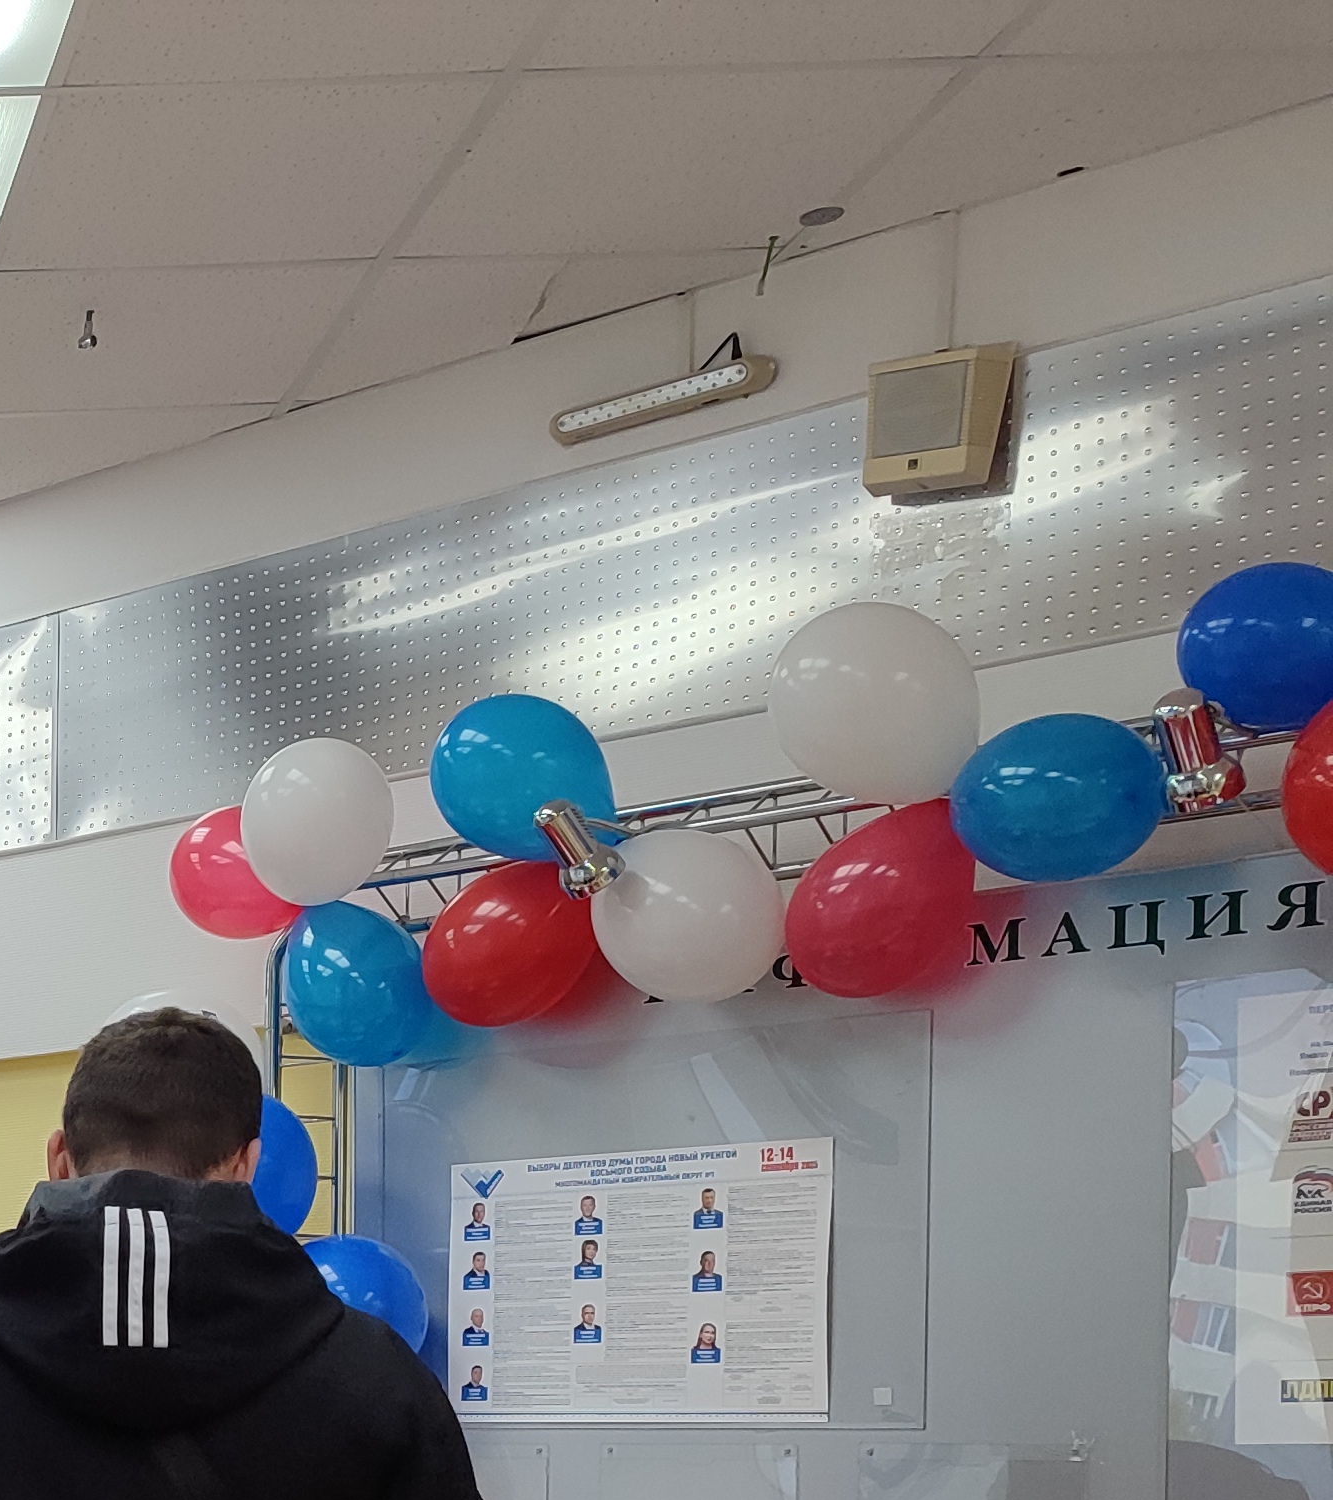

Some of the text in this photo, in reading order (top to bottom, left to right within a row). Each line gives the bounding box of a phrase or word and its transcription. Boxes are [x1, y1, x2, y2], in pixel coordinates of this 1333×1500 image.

[527, 1148, 738, 1173] ВЫБОРЫ ДЕПУТАТОВ ДУМЫ ГОРОДА НОВЫЙ УРЕНГОЙ
[760, 1146, 795, 1162] 12-14
[590, 1167, 633, 1177] ВОСЬМОГО
